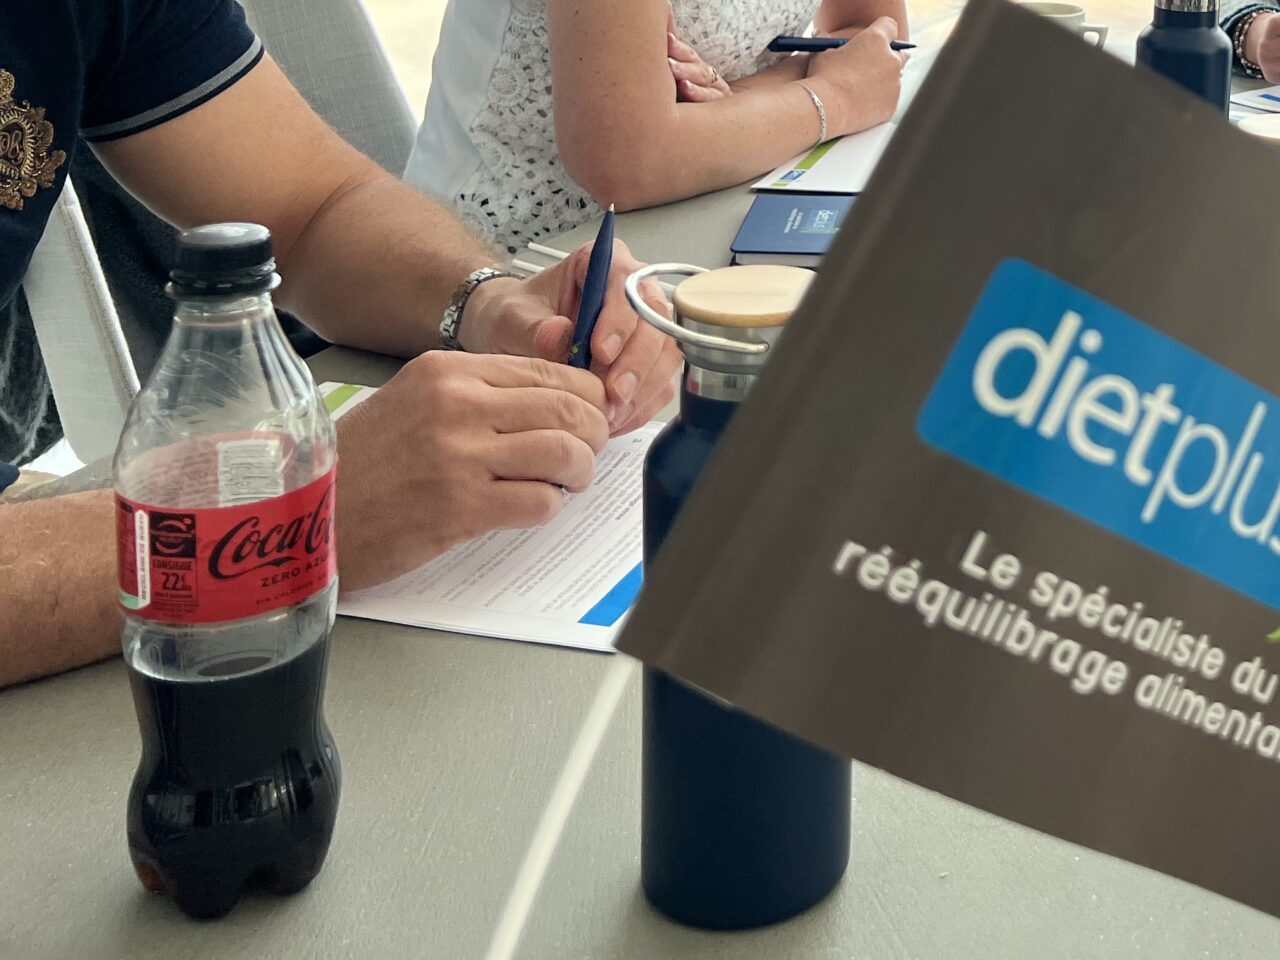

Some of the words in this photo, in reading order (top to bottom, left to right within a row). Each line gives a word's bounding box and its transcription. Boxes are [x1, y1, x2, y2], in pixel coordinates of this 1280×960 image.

[261, 567, 301, 588] ZERO
[833, 539, 1127, 695] rééquilibrage
[959, 530, 1023, 590] Le
[1028, 569, 1225, 681] spécialiste
[1231, 654, 1280, 705] du
